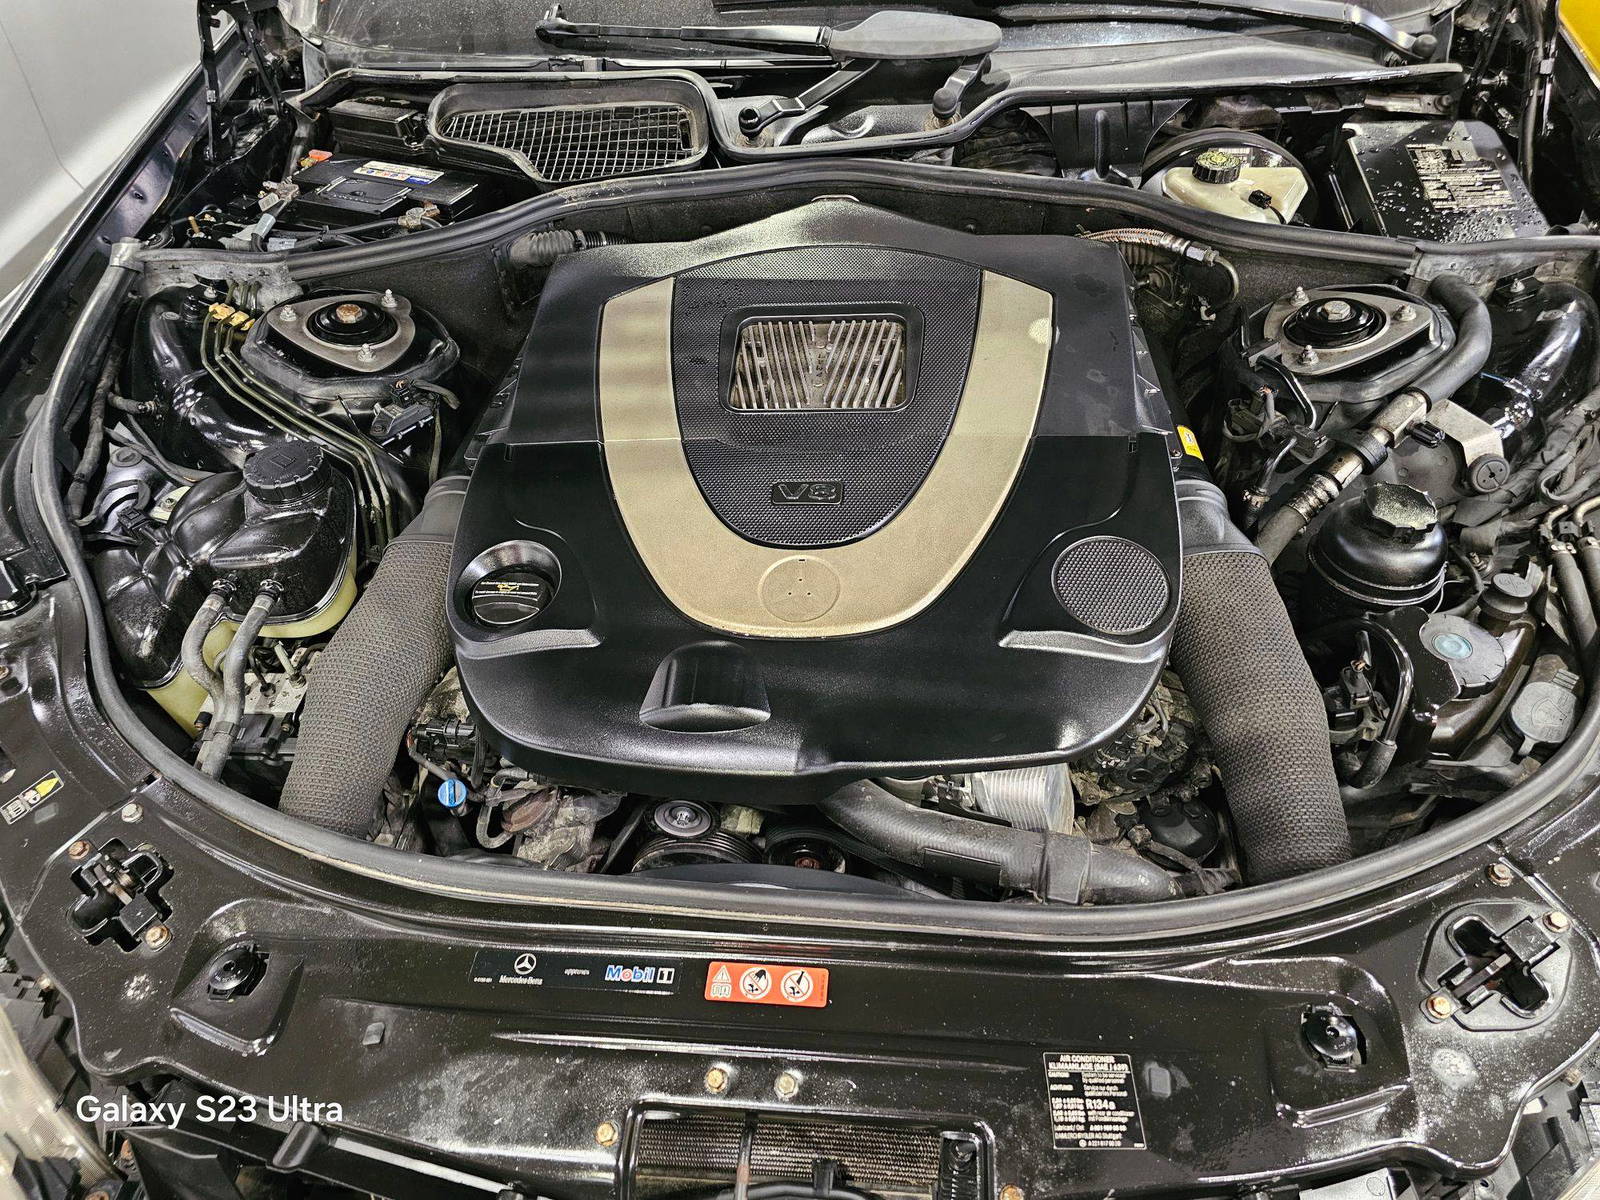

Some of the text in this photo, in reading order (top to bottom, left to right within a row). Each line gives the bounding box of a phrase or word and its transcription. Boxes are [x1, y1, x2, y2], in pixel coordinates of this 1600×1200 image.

[777, 484, 836, 500] V8
[605, 964, 655, 983] Mobil
[499, 974, 543, 985] Mercedes-Benz
[1072, 1055, 1115, 1063] CONDITIONER
[1049, 1062, 1093, 1070] KLIMAANLAGE
